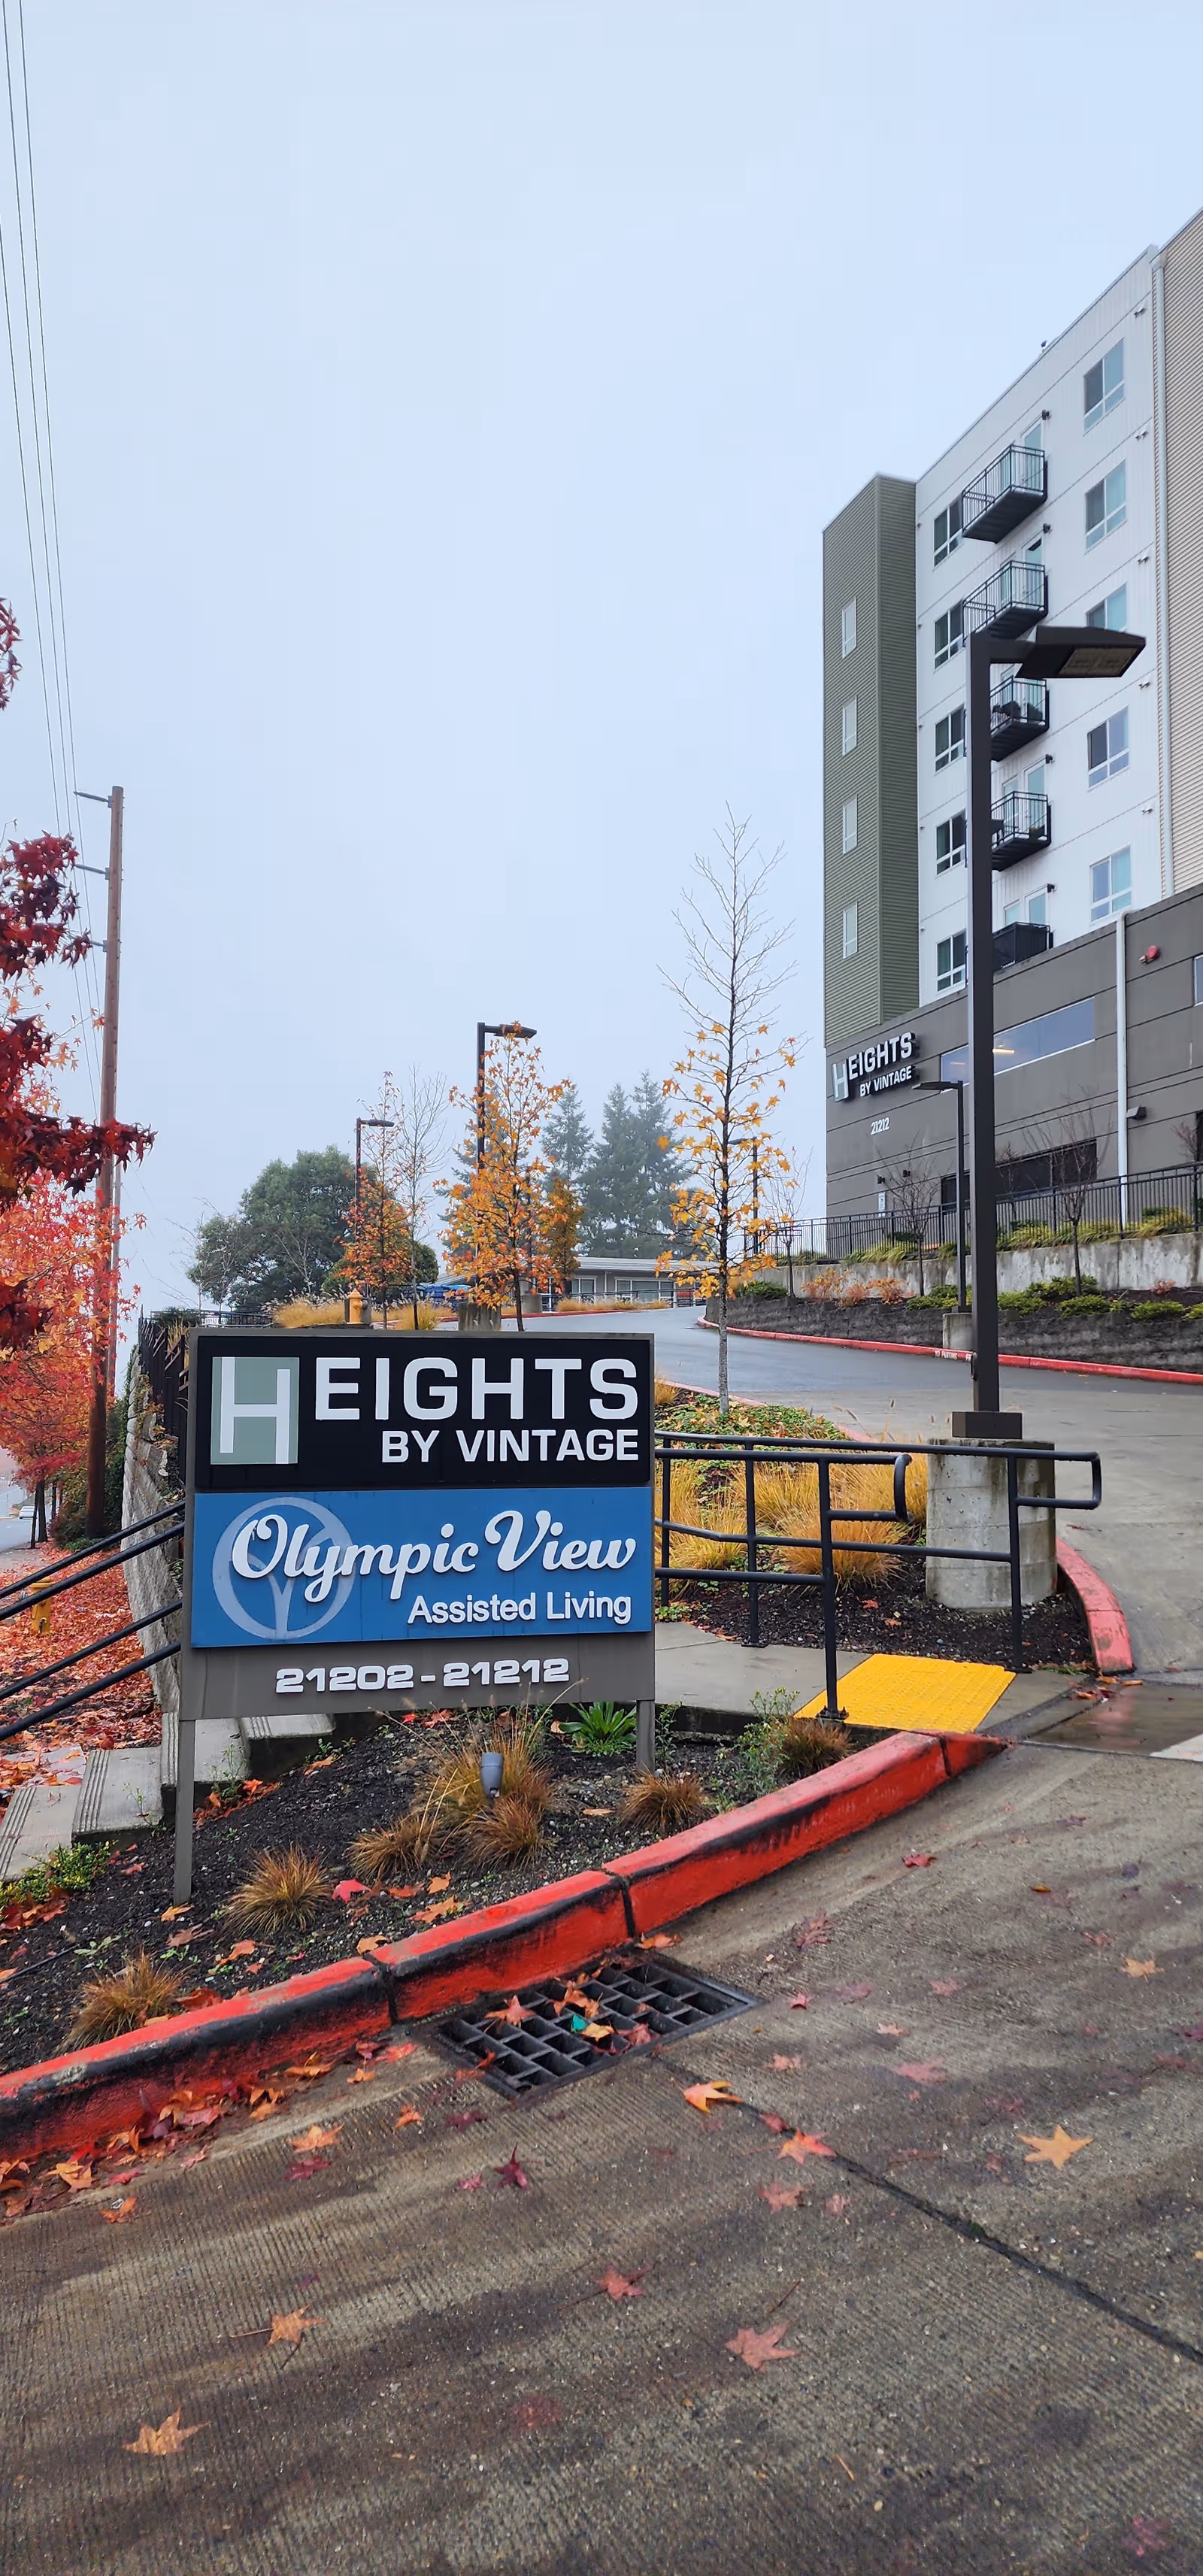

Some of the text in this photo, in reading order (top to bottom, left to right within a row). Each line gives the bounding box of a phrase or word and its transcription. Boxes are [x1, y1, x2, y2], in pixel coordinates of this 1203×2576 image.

[832, 1032, 912, 1099] HEIGHTS
[859, 1065, 912, 1097] BY VINTAGE
[870, 1117, 890, 1135] 21212
[219, 1356, 638, 1465] HEIGHTS
[382, 1429, 639, 1463] BY VINTAGE
[232, 1510, 638, 1604] Olympic View
[407, 1590, 632, 1626] Assisted Living
[275, 1663, 414, 1694] 21202
[443, 1658, 570, 1687] 21212
